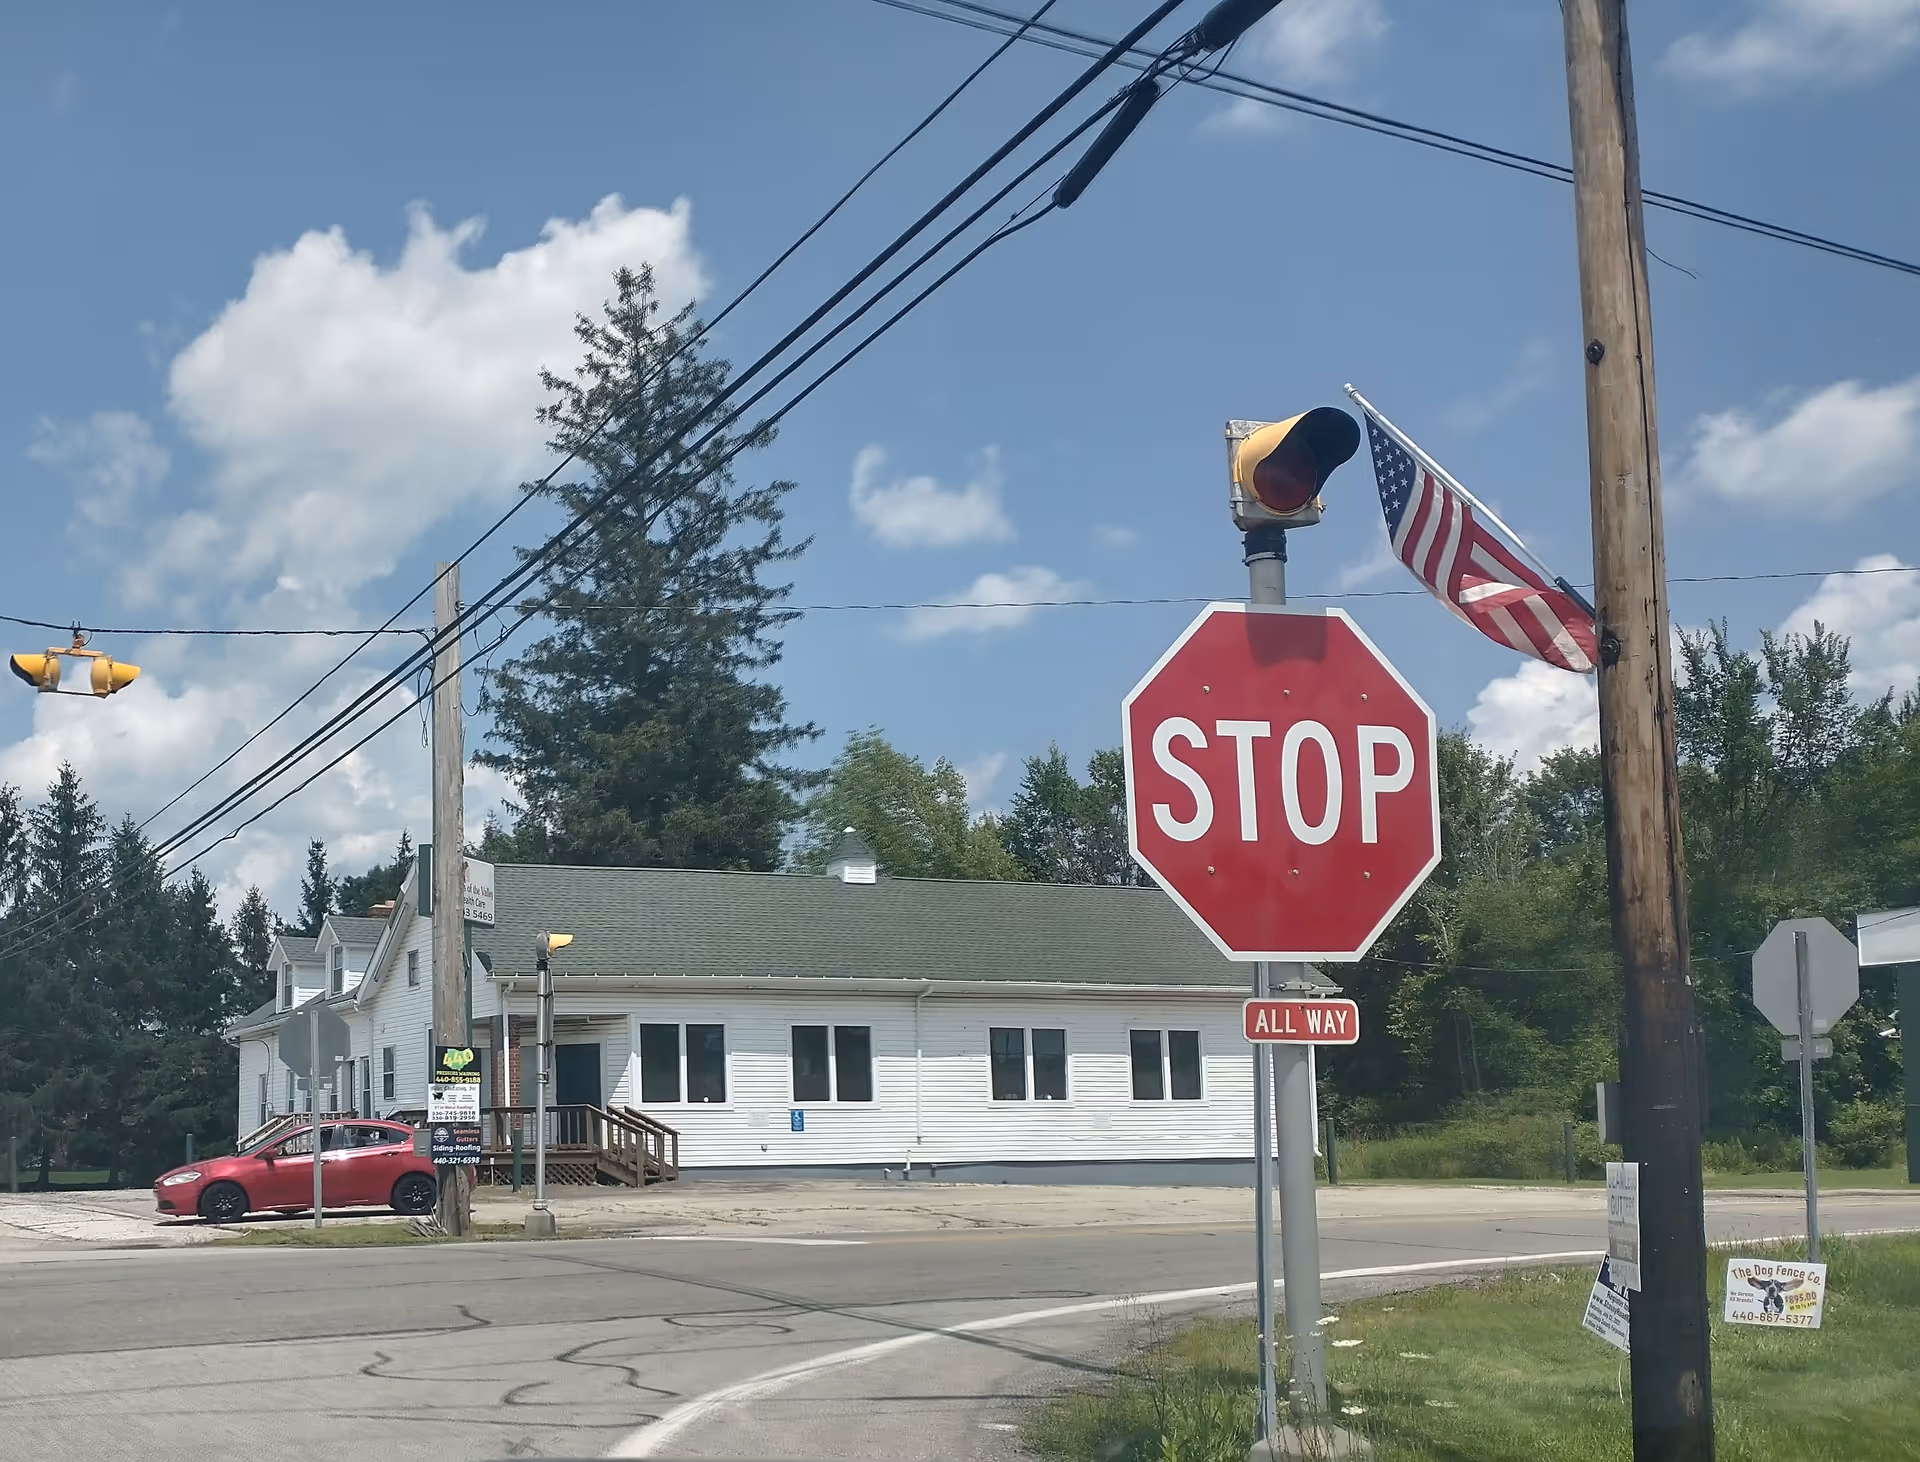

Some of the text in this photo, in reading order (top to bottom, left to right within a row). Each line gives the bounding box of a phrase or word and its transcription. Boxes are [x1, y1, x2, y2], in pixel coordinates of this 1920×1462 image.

[1152, 716, 1415, 846] STOP
[475, 898, 486, 908] Care
[472, 909, 493, 921] 5469
[1255, 1009, 1348, 1035] ALL WAY
[443, 1047, 474, 1067] 440
[435, 1076, 481, 1084] 440-855-9188
[432, 1156, 480, 1165] 440-321-6598
[1731, 1264, 1821, 1286] The Dog Fence Co.
[1784, 1291, 1817, 1304] $895.00
[1732, 1310, 1813, 1325] 440-667-5377
